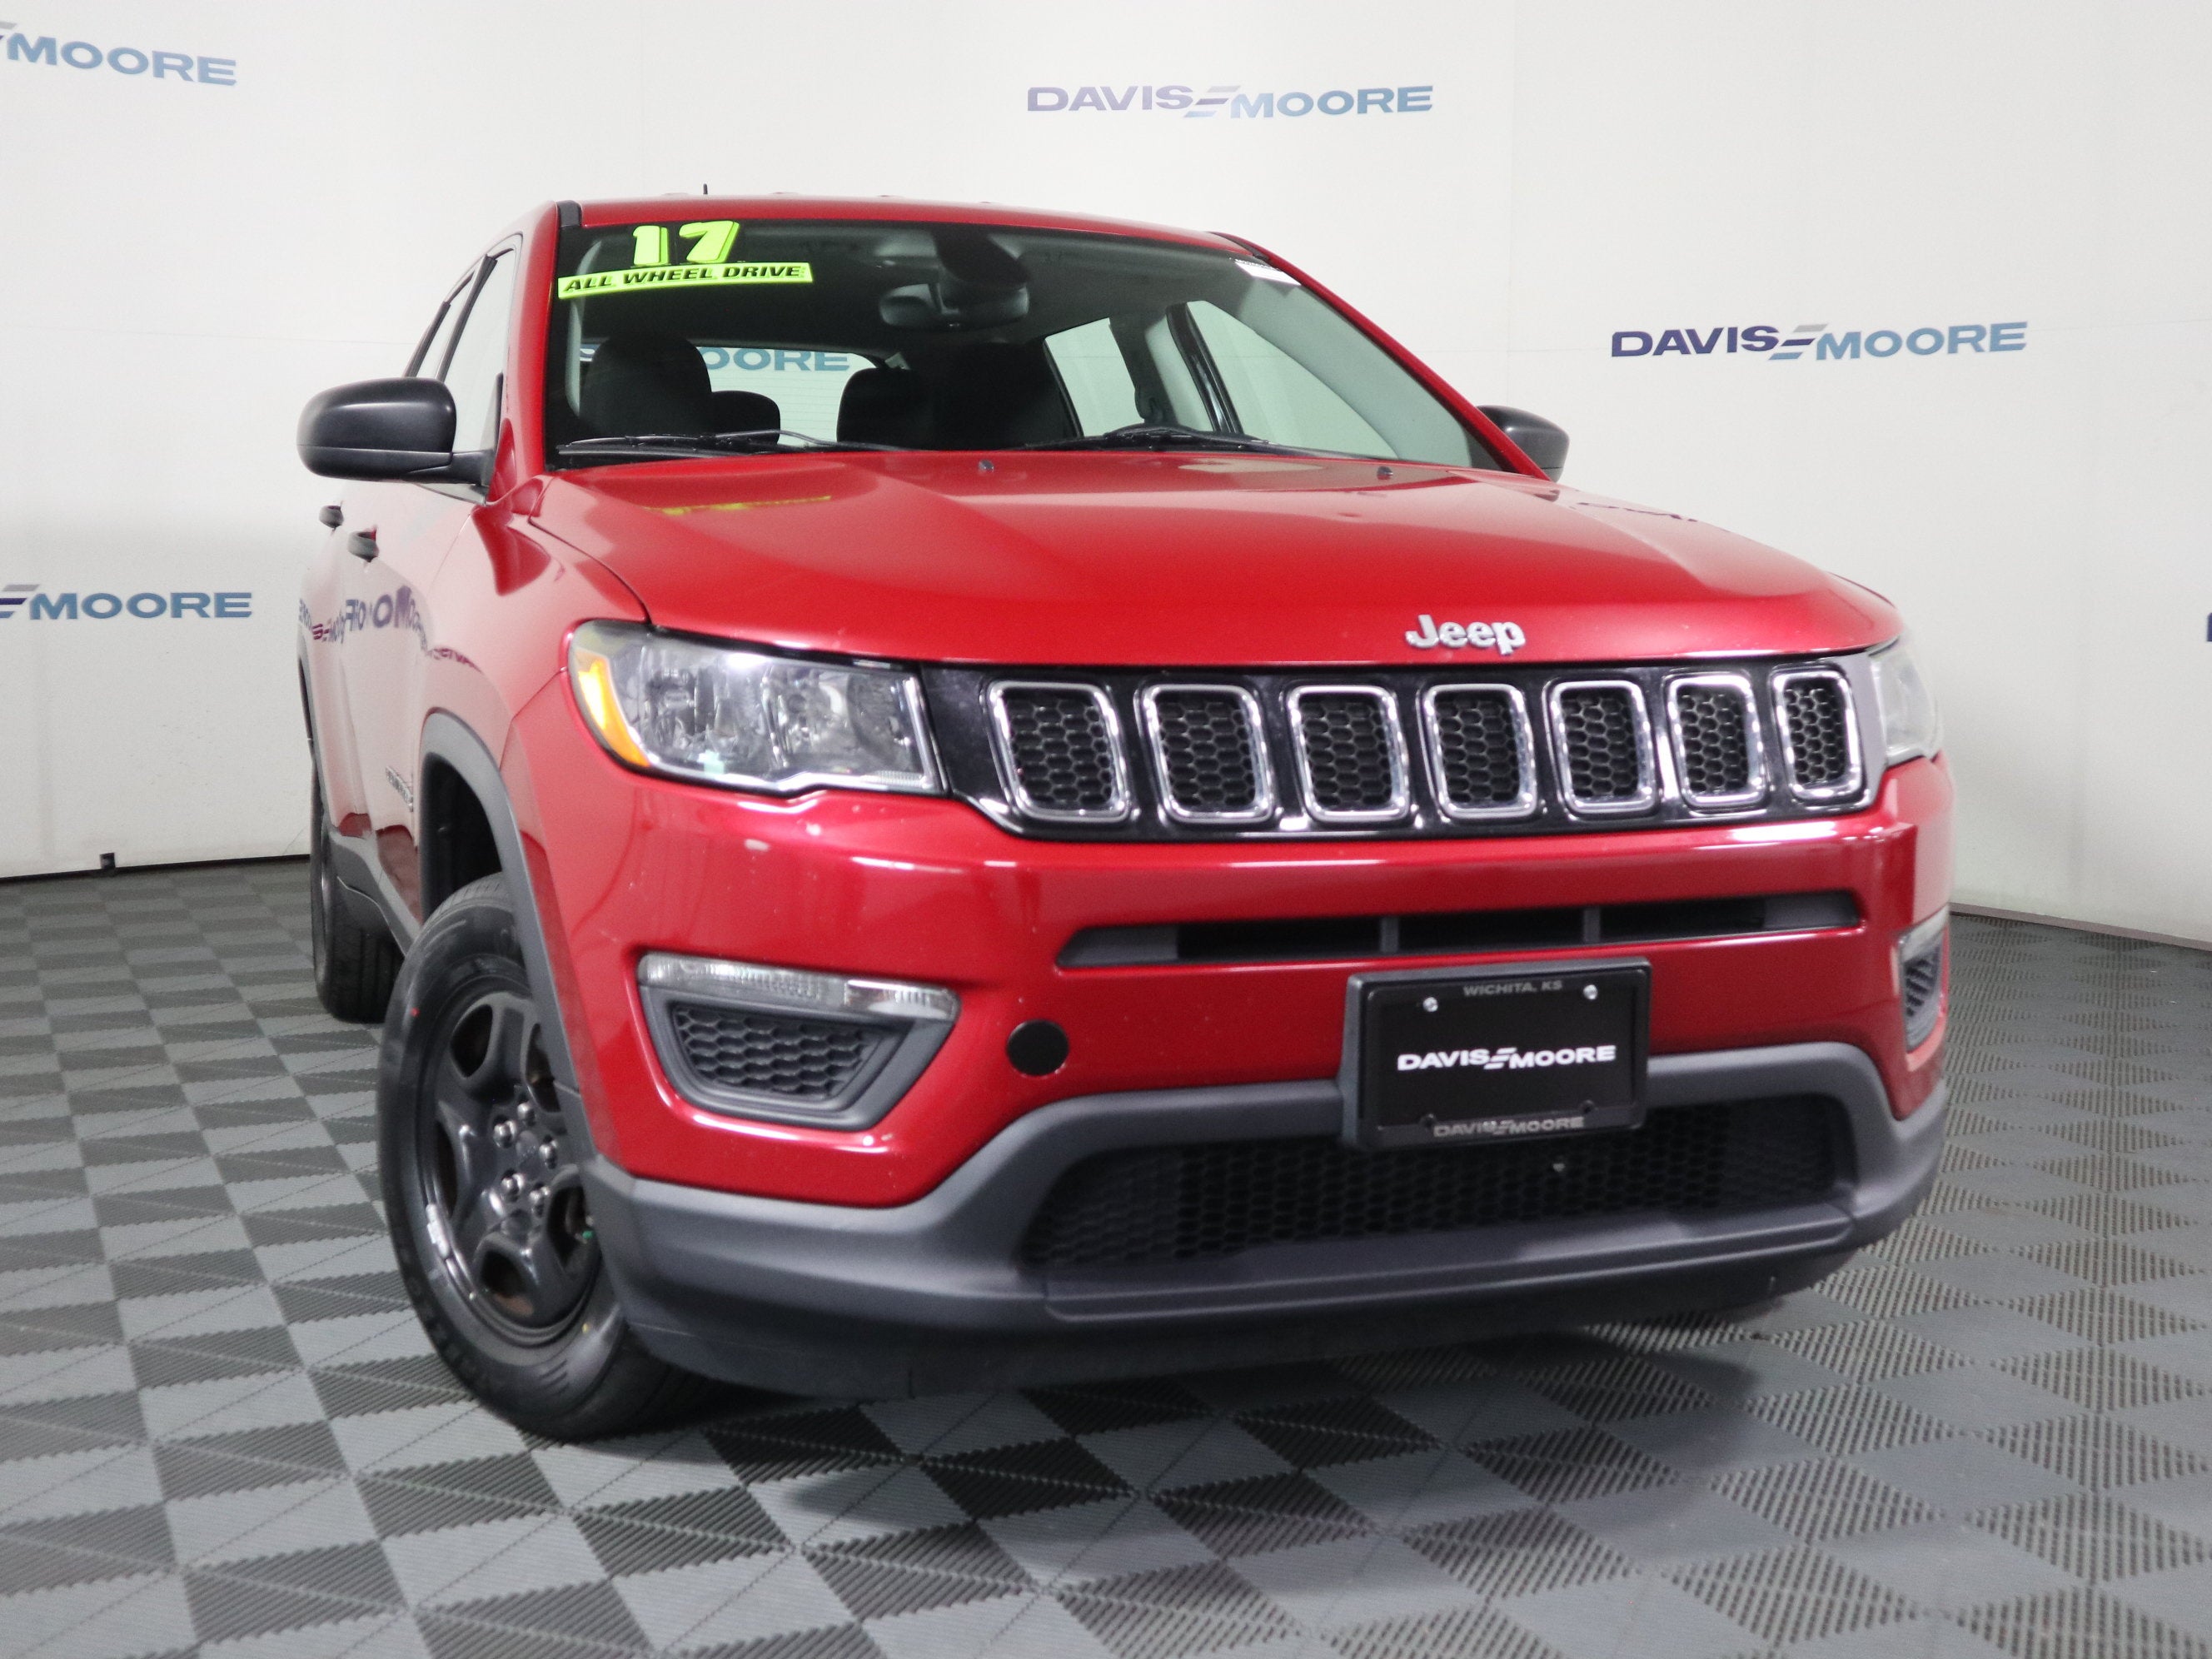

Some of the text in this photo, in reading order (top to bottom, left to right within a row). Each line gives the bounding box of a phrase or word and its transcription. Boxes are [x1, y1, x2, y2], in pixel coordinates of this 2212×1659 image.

[6, 32, 237, 87] MOORE
[1027, 85, 1434, 119] DAVIS MOORE
[632, 220, 740, 267] 17
[563, 265, 804, 292] ALL WHEEL DRIVE
[1611, 321, 2029, 361] DAVIS MOORE
[699, 346, 851, 371] OORE
[29, 591, 253, 620] MOORE
[1404, 614, 1527, 656] Jeep
[1541, 979, 1563, 992] KS
[1397, 1044, 1617, 1071] DAVIS MOORE
[1508, 1116, 1584, 1134] MOORE
